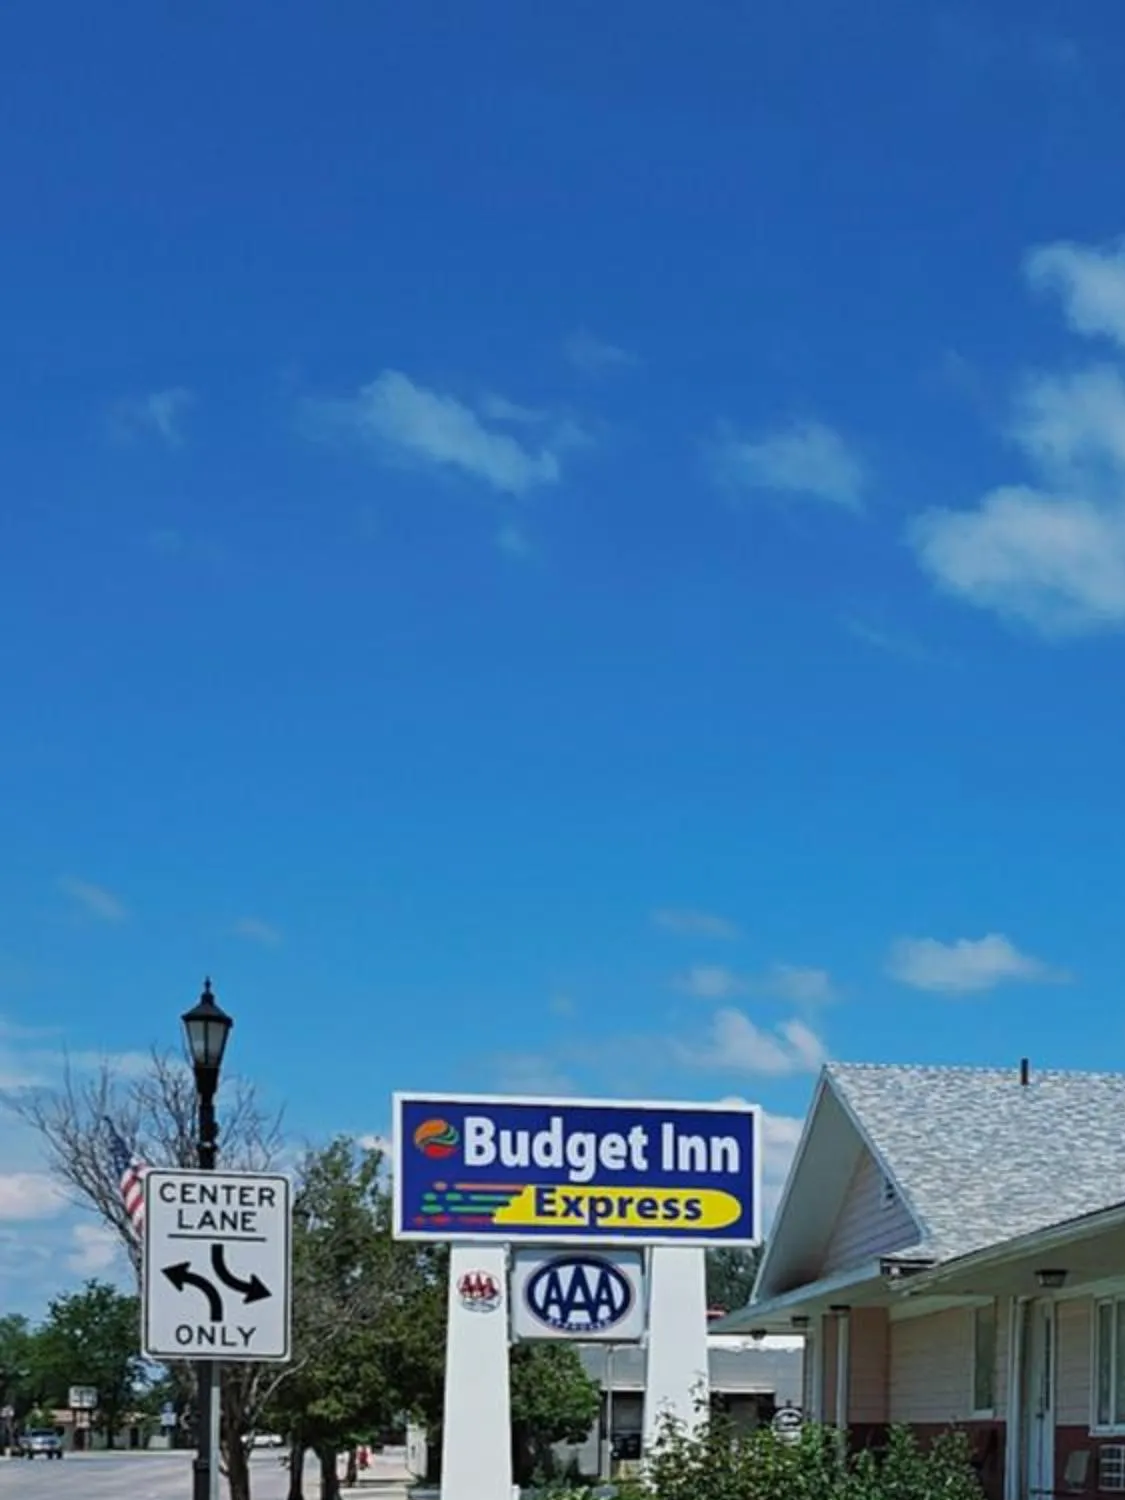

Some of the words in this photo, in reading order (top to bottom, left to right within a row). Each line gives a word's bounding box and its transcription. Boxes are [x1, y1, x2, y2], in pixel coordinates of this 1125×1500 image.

[463, 1115, 648, 1183] Budget
[661, 1122, 739, 1174] Inn
[159, 1181, 276, 1207] CENTER
[534, 1187, 703, 1229] Express
[177, 1208, 257, 1232] LANE
[542, 1265, 617, 1325] AAA
[175, 1324, 257, 1347] ONLY
